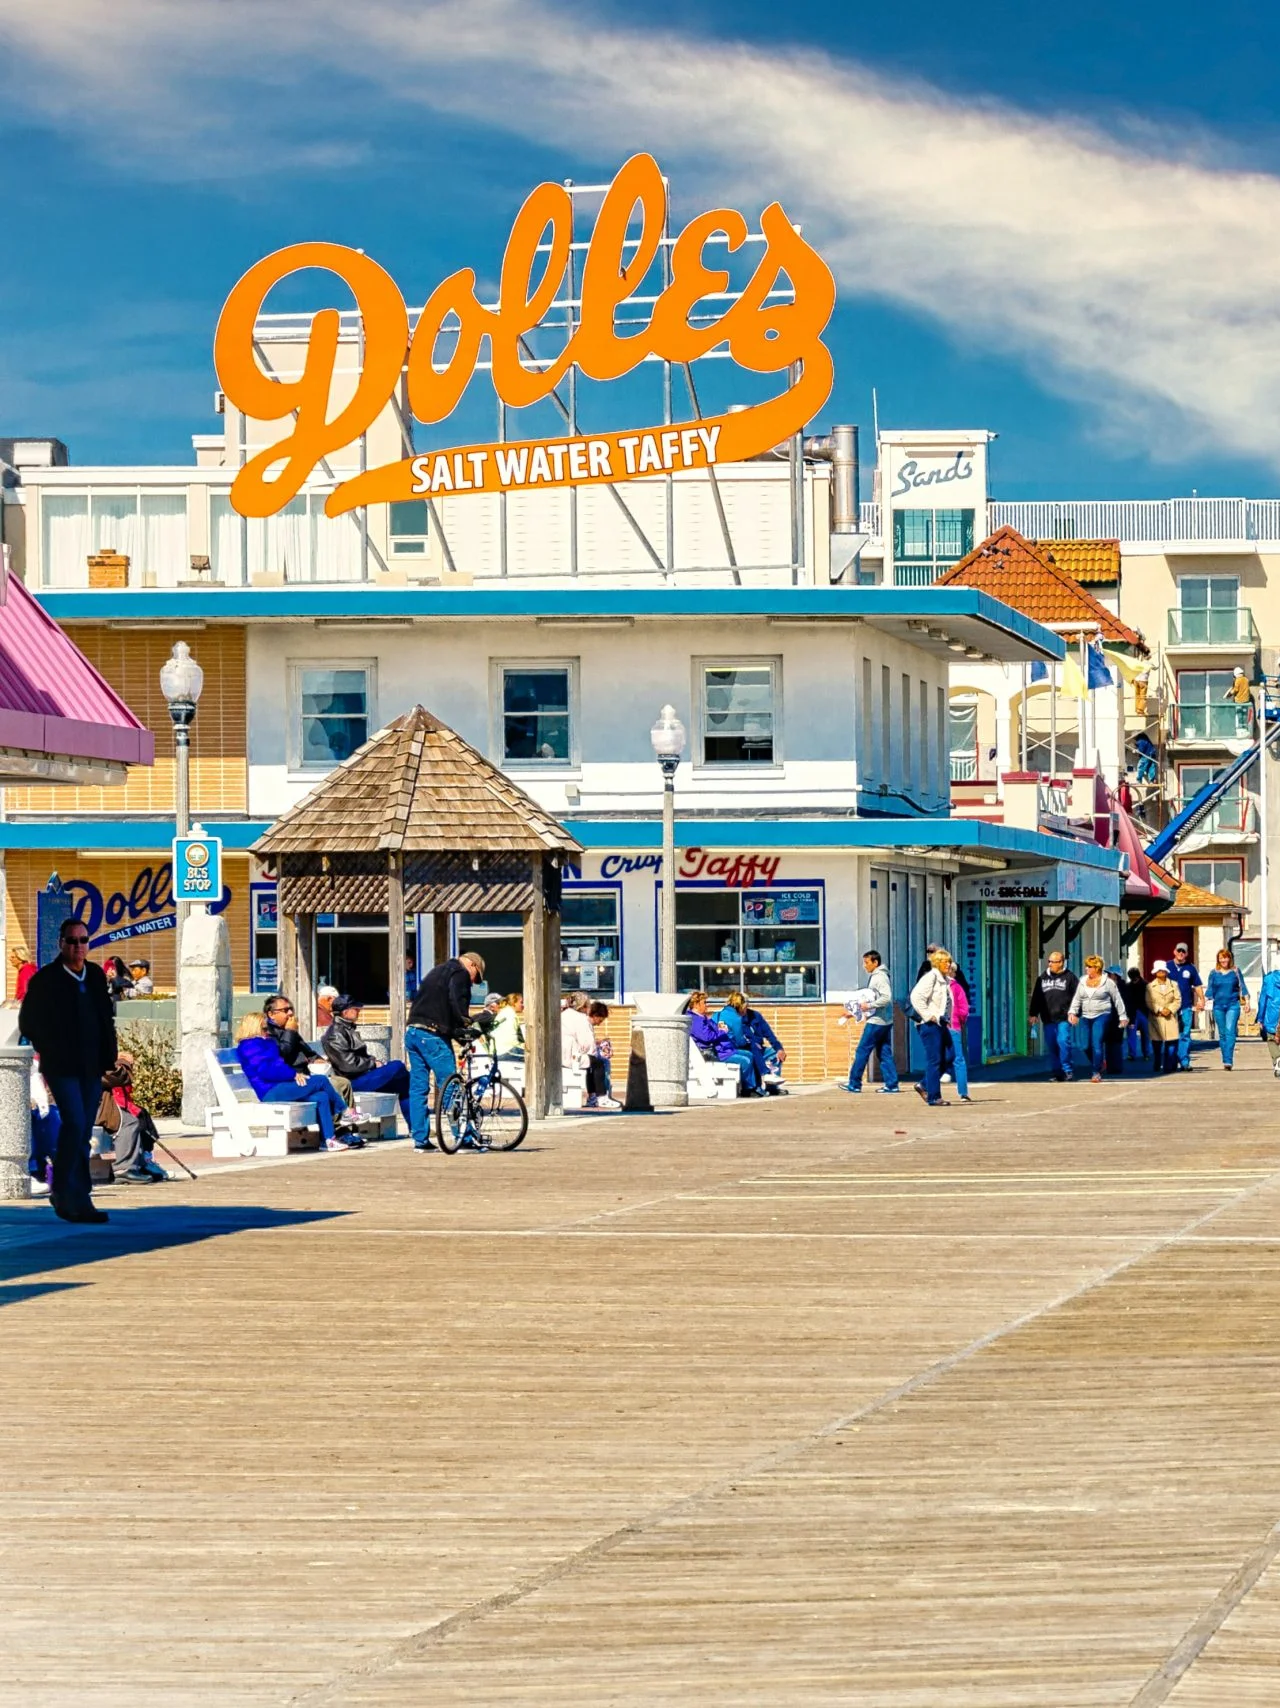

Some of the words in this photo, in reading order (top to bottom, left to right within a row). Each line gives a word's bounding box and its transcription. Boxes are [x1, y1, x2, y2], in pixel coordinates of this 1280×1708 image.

[411, 451, 488, 494] SALT
[494, 440, 614, 486] WATER
[617, 425, 722, 475] TAFFY
[891, 451, 973, 497] Sands
[187, 867, 208, 879] BUS
[679, 847, 781, 888] Taffy
[183, 879, 212, 891] STOP
[108, 928, 132, 942] SALT
[135, 917, 172, 935] WATER
